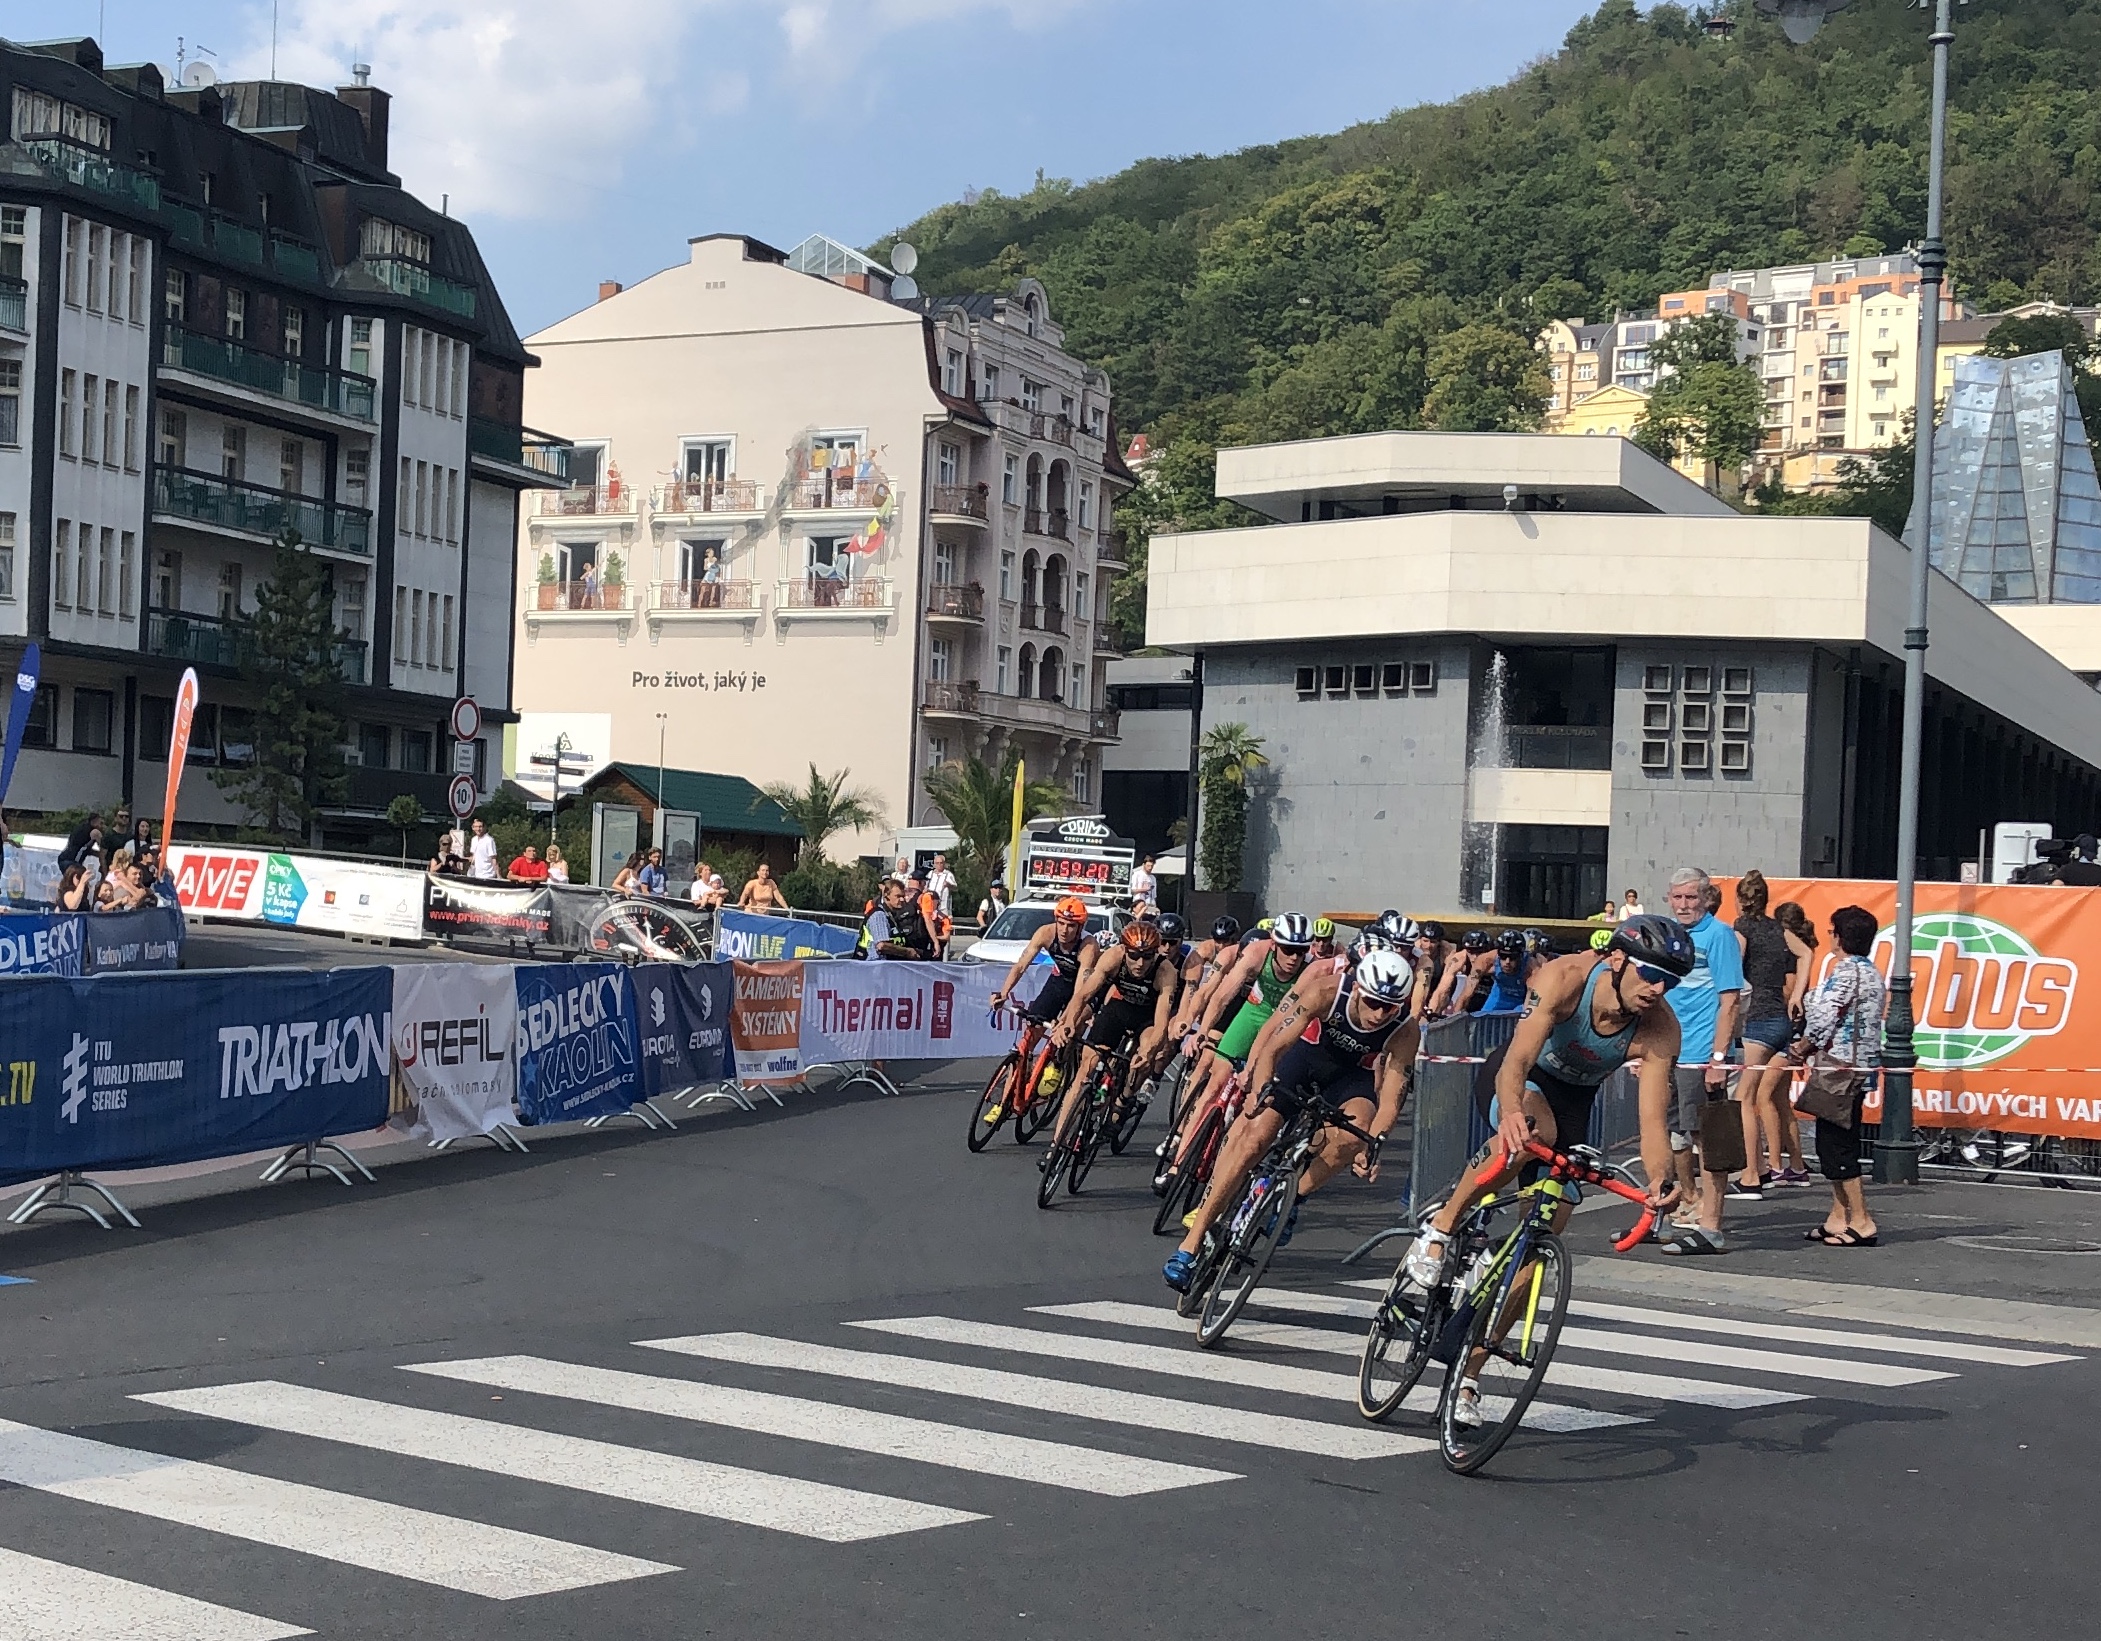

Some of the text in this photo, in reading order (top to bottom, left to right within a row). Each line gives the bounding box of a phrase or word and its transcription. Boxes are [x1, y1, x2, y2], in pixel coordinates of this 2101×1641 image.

[632, 670, 767, 692] Pro život, jaký je
[1067, 819, 1101, 837] PRIM
[177, 866, 252, 898] AVE
[266, 881, 293, 898] 5 Kč
[741, 1006, 797, 1036] SYSTÉMY
[817, 989, 923, 1033] Thermal
[94, 1040, 112, 1061] ITU
[218, 1012, 391, 1099] TRIATHLON
[538, 1018, 634, 1102] KAOLIN
[93, 1059, 184, 1087] WORLD TRIATHLON
[91, 1089, 128, 1112] SERIES
[1911, 1087, 2047, 1119] ARLOVÝCH
